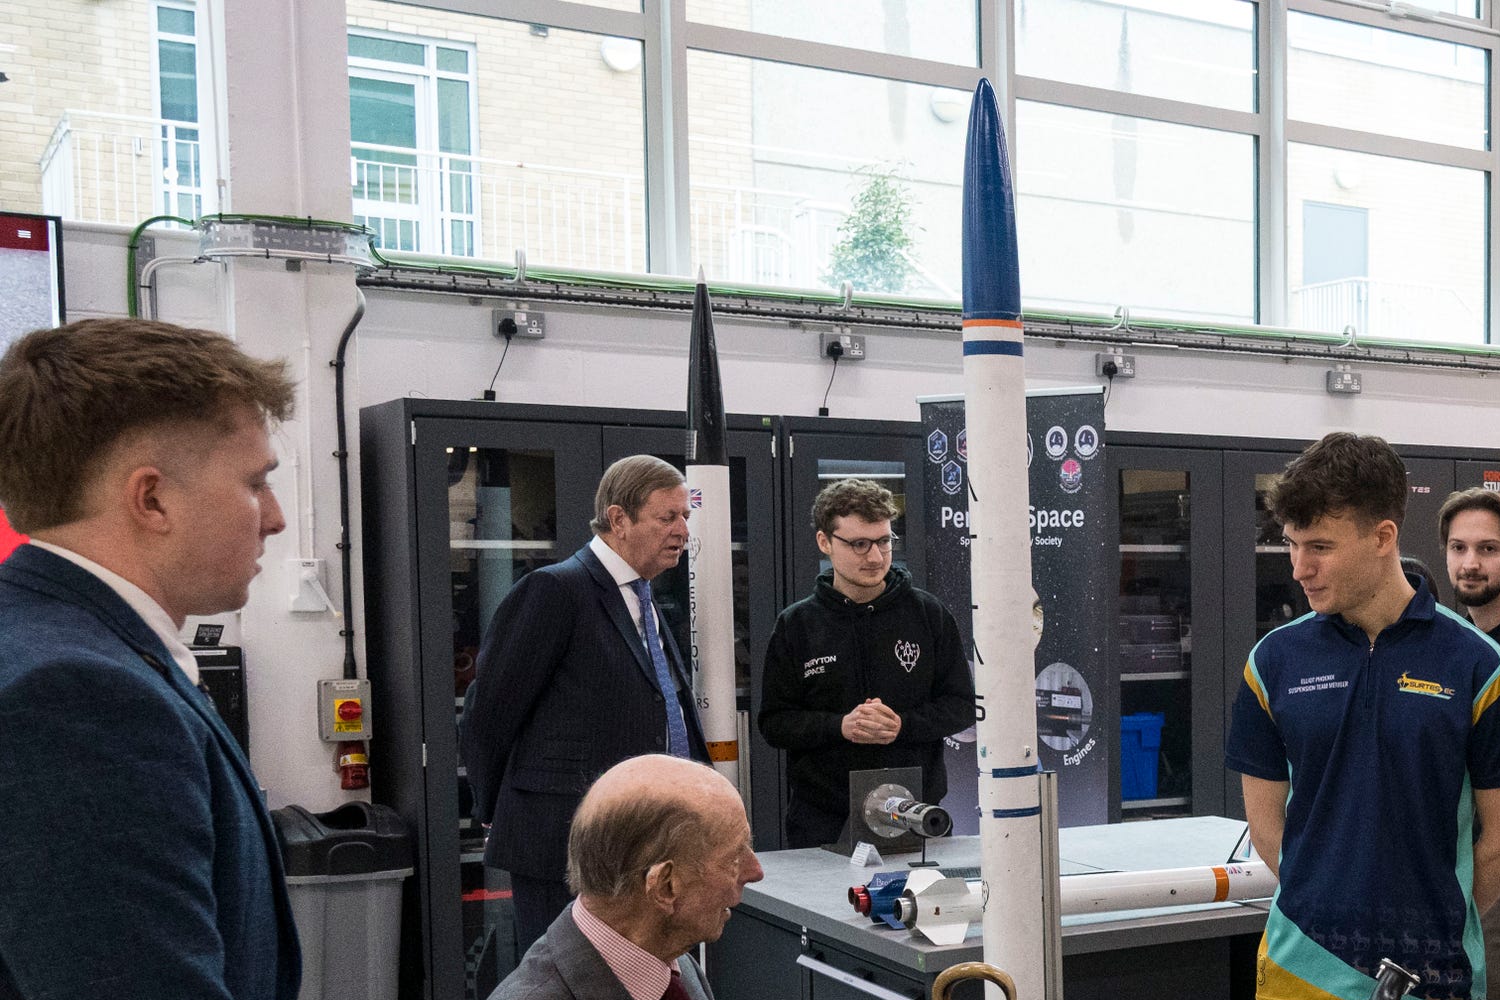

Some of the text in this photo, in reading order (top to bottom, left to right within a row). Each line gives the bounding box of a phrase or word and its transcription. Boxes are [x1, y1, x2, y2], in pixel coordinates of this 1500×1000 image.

[1035, 536, 1062, 548] Society
[1410, 681, 1440, 692] SURTES
[697, 698, 710, 709] RS
[1063, 738, 1096, 766] Engines
